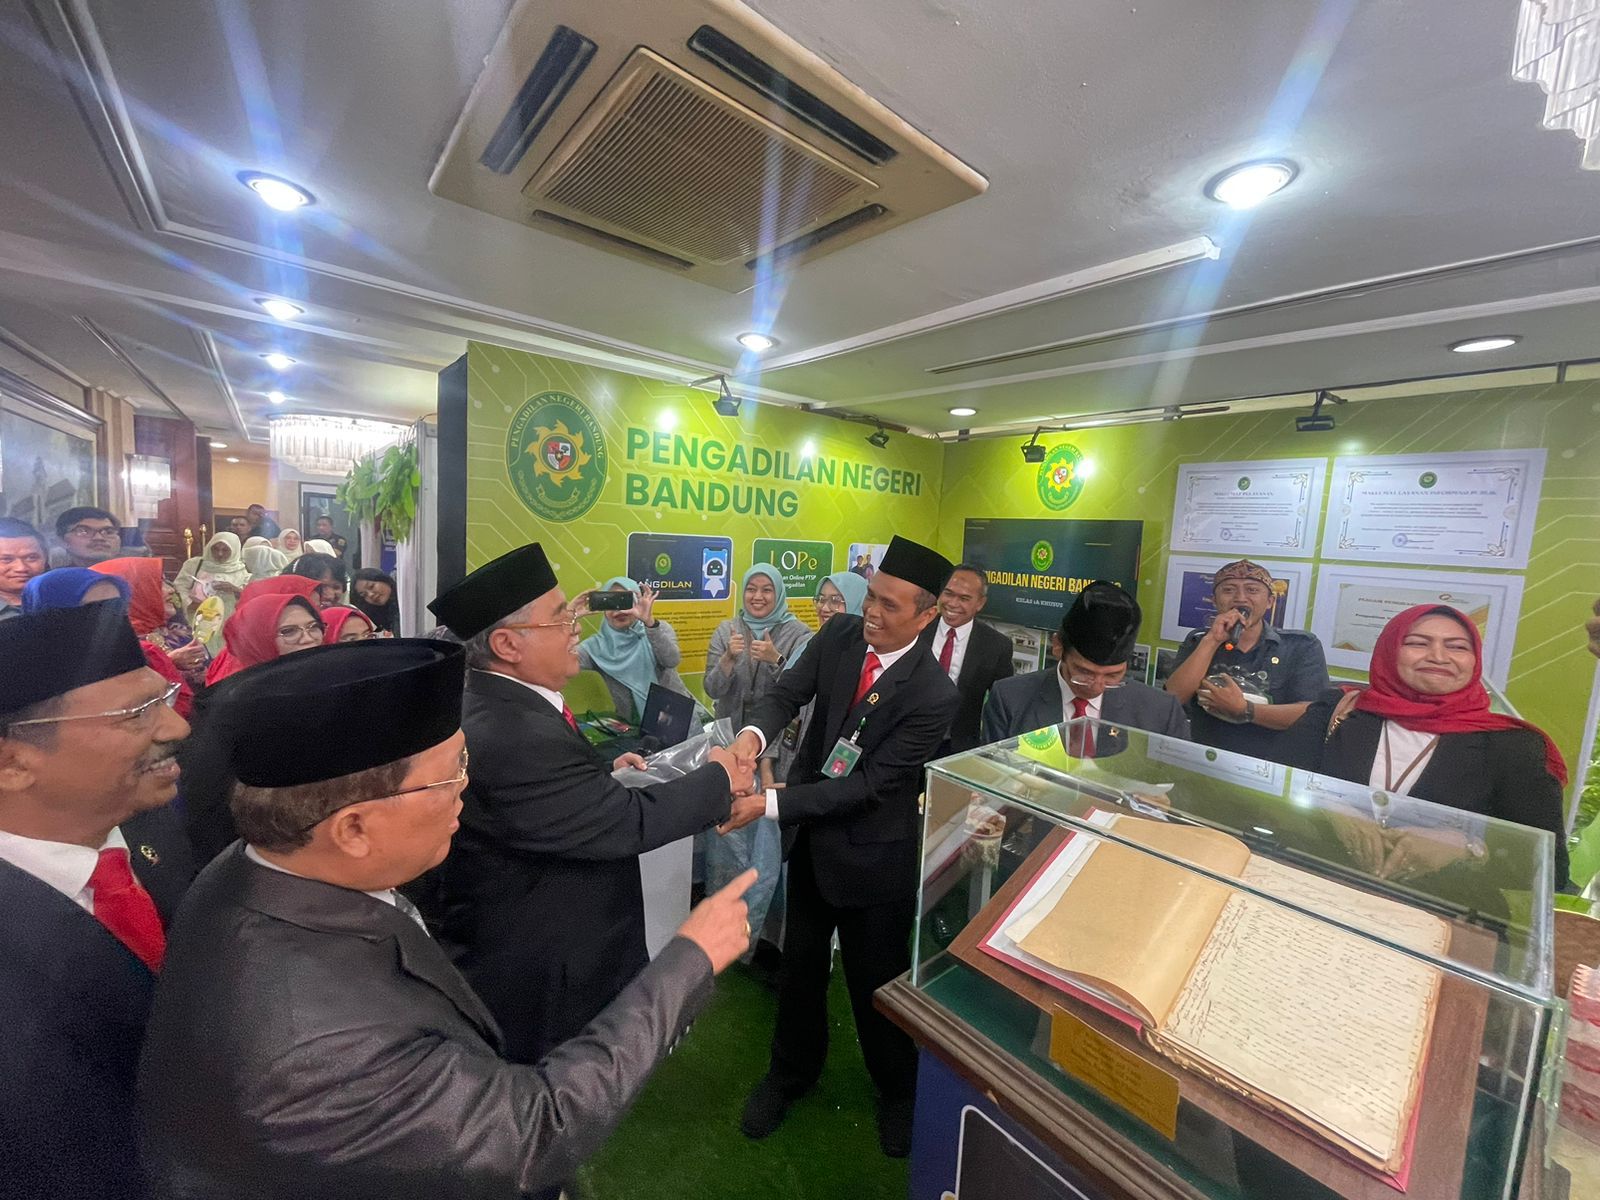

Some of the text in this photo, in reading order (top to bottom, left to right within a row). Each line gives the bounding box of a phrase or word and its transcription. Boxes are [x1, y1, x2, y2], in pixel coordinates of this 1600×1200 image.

[511, 394, 605, 458] PENGADILAN NEGERI BANDUNG
[626, 427, 922, 496] PENGADILAN NEGERI
[625, 472, 799, 518] BANDUNG
[1031, 574, 1066, 591] NEGERI
